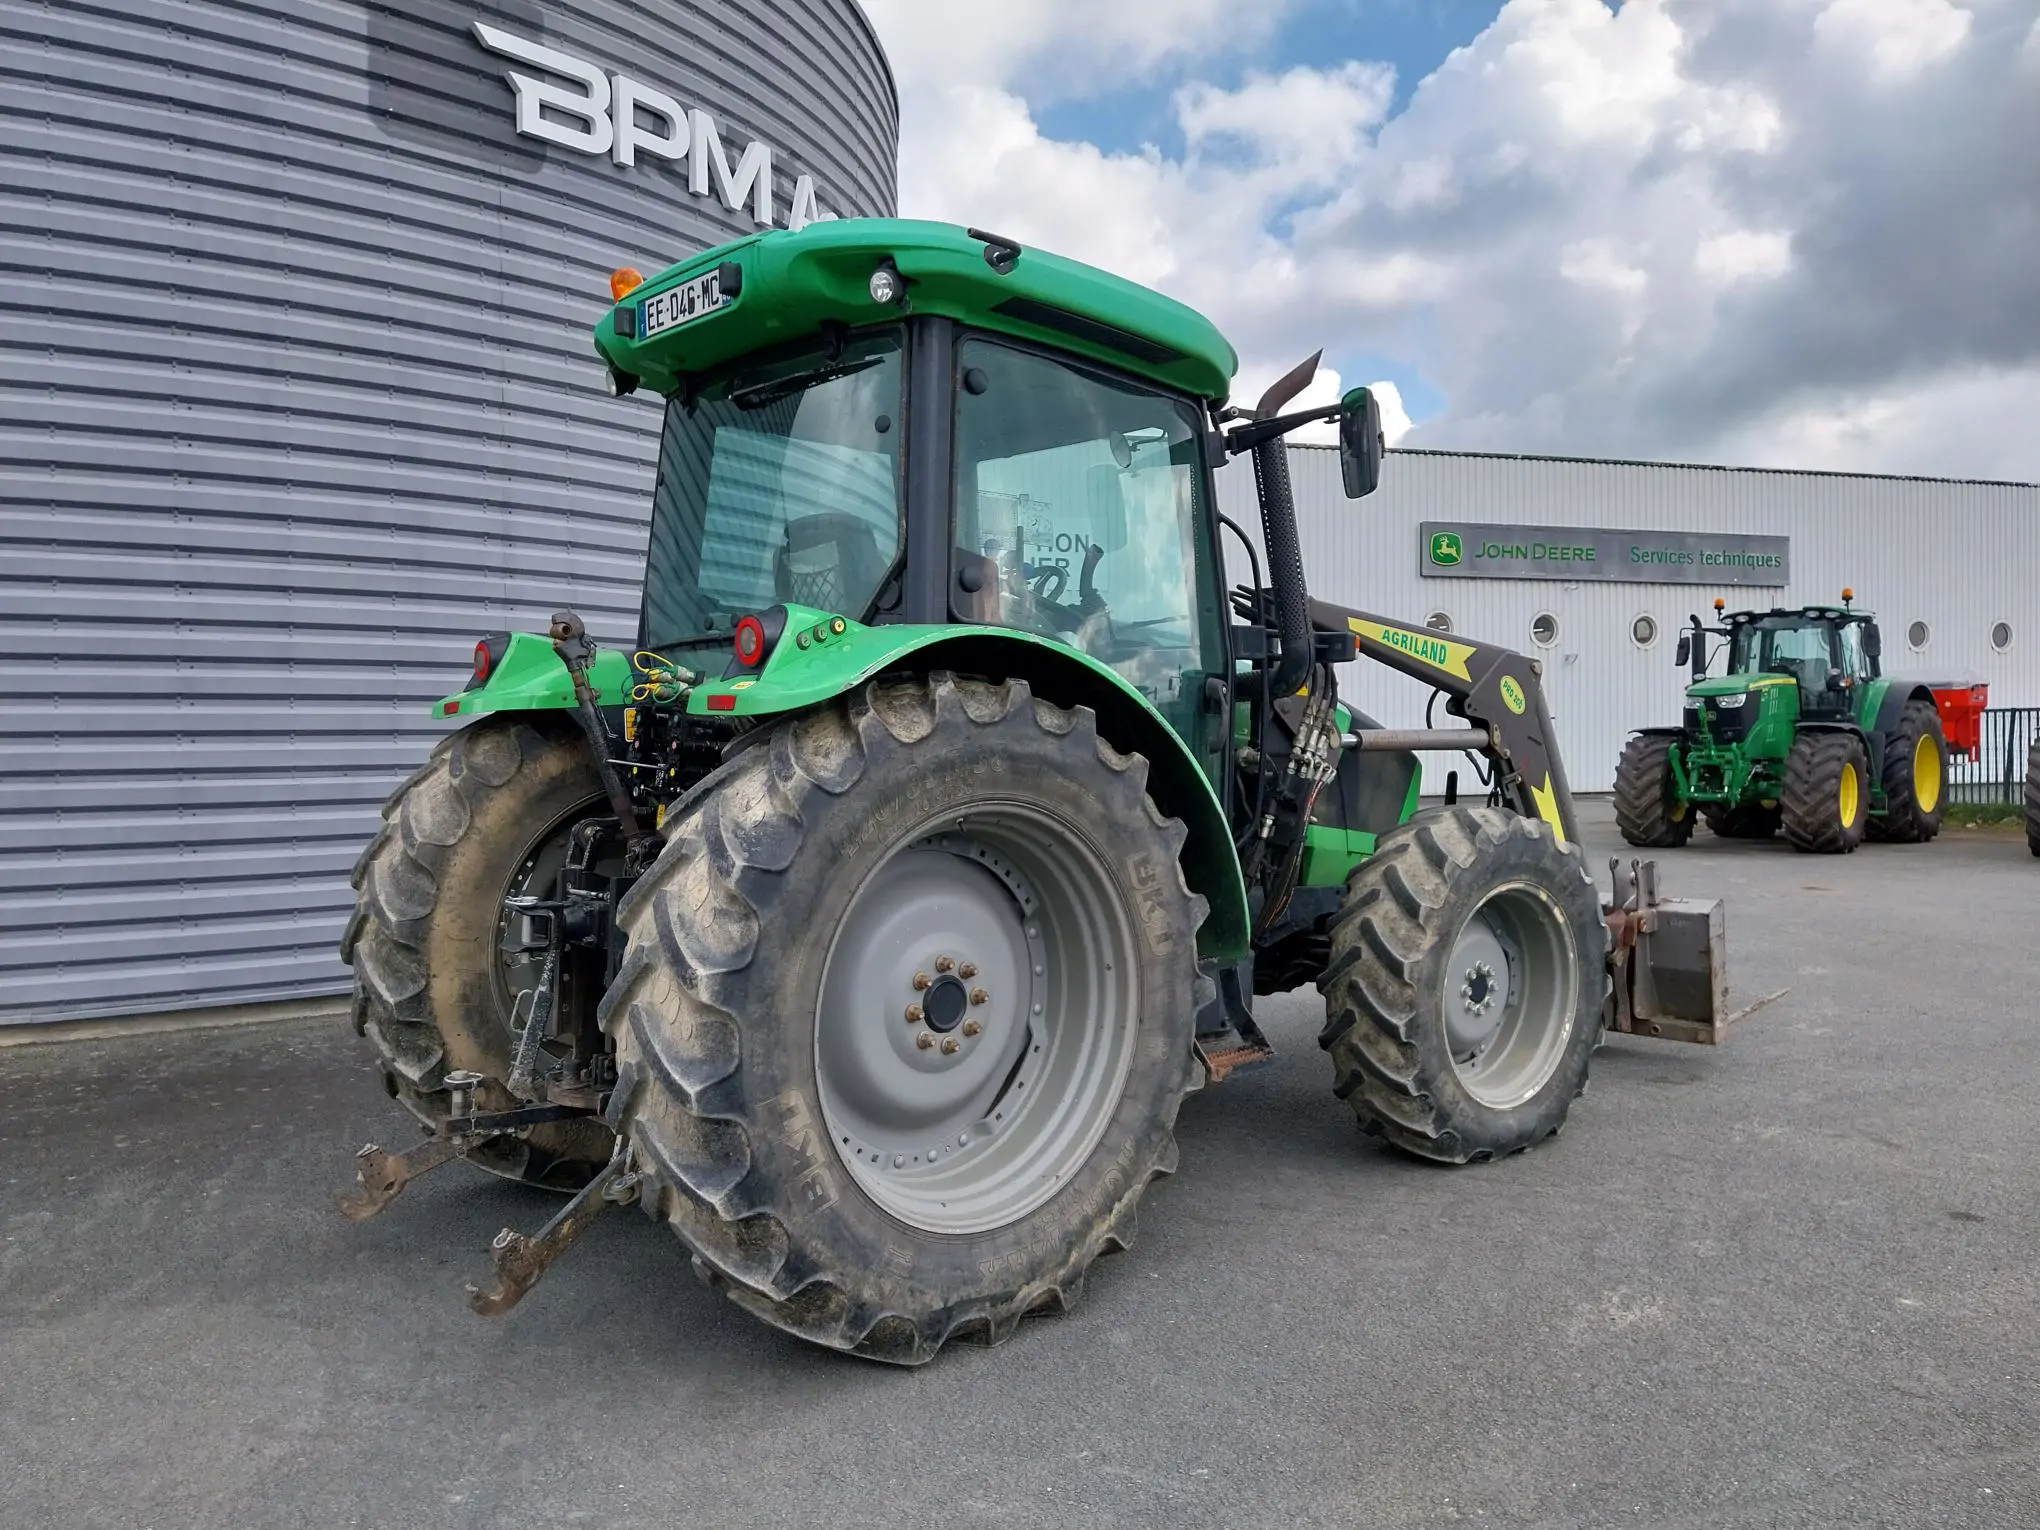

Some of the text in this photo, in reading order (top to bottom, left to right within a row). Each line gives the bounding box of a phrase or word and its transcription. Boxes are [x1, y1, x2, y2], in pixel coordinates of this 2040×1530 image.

[1475, 541, 1782, 571] JOHN DEERE Services techniques
[1382, 629, 1447, 665] AGRILAND
